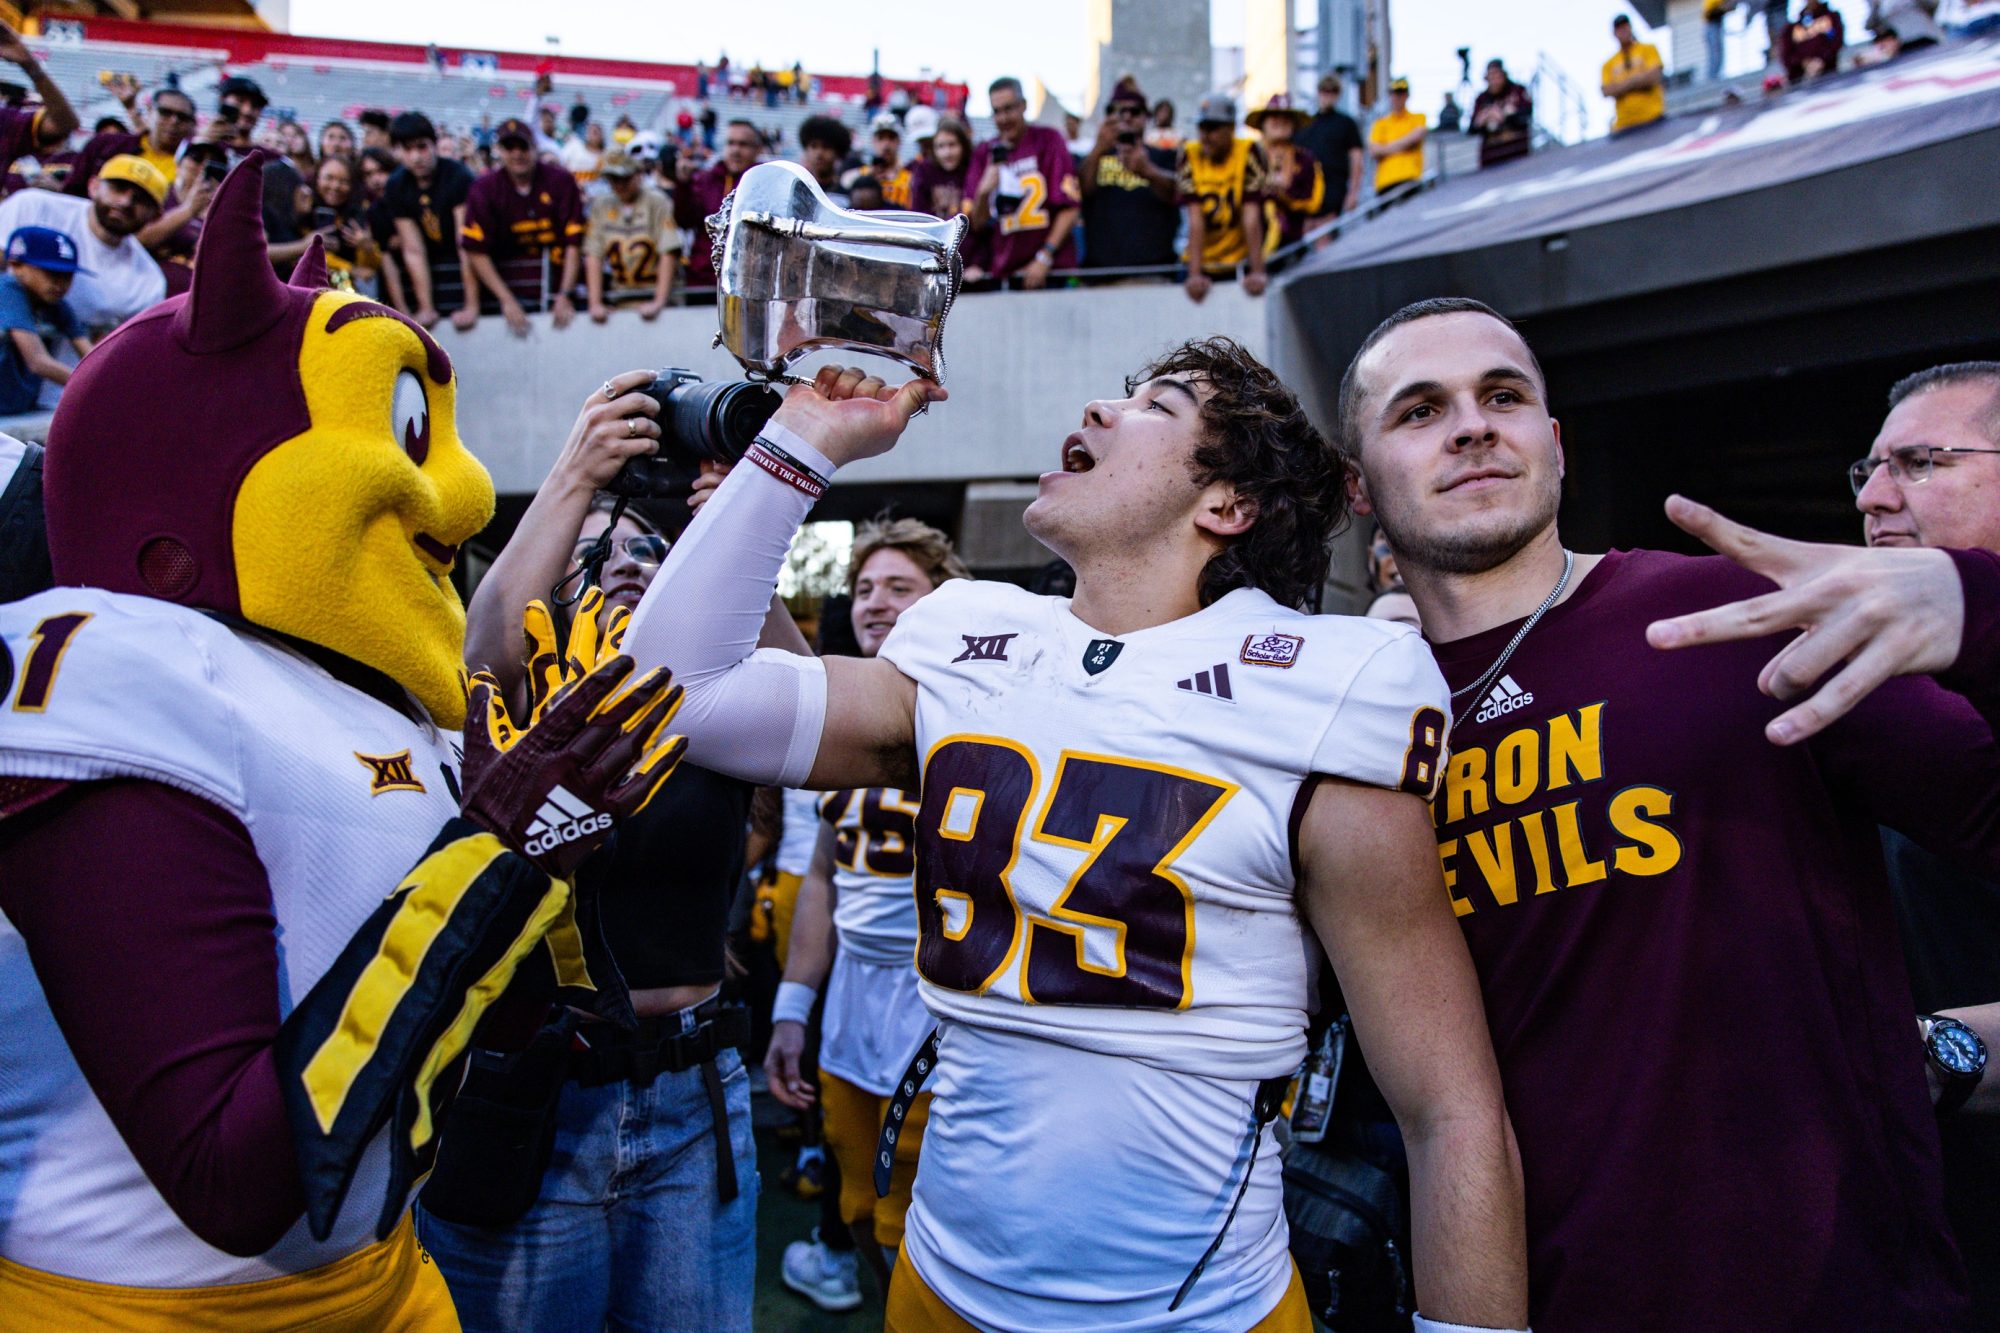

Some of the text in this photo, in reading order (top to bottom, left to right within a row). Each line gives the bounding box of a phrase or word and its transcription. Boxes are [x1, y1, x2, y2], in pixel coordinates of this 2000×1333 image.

[1200, 188, 1239, 231] 21
[606, 239, 658, 285] 42
[780, 467, 796, 483] THE
[796, 477, 822, 496] VALLEY
[12, 611, 96, 714] 1
[951, 633, 1019, 664] XII
[1091, 655, 1106, 665] 42
[1097, 643, 1113, 653] PT
[1475, 692, 1534, 723] adidas
[355, 749, 425, 793] XII
[1399, 705, 1448, 802] 8
[1427, 700, 1608, 829] RON
[523, 812, 614, 857] adidas
[1436, 785, 1683, 919] EVILS
[914, 732, 1241, 1011] 83
